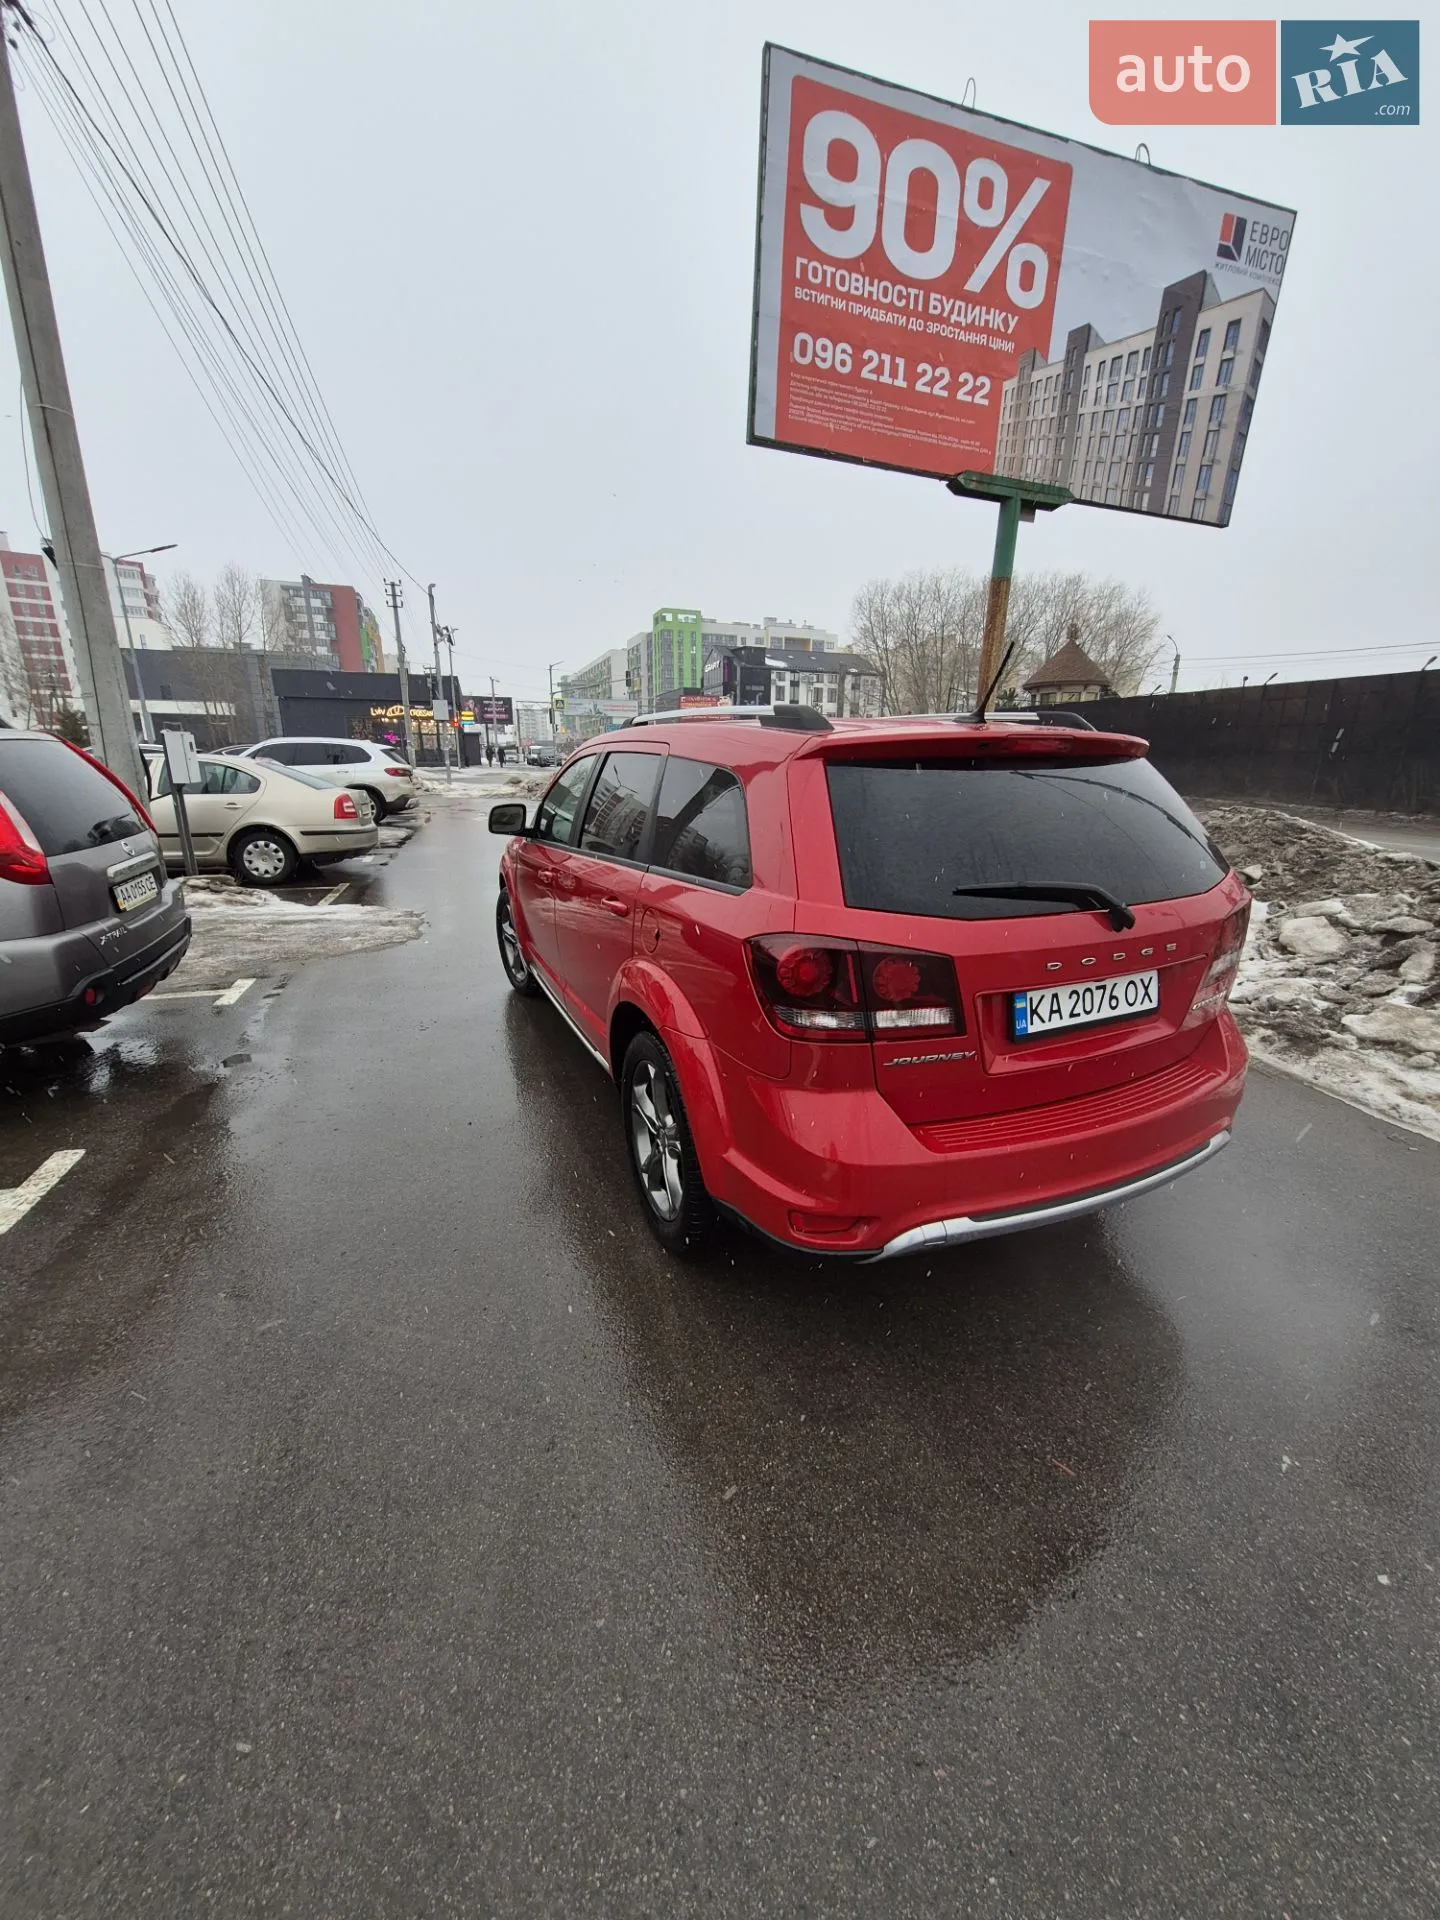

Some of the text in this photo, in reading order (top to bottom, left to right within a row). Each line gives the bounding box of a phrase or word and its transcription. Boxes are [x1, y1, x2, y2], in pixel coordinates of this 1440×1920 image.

[799, 109, 1052, 310] 90%
[1249, 220, 1290, 252] ЕВРО
[1244, 245, 1285, 275] МІСТО
[794, 256, 1020, 336] ГОТОВНОСТІ БУДИНКУ
[794, 286, 1015, 354] ВСТИГНИ ПРИДБАТИ ДО ЗРОСТАННЯ ЦІНИ!
[792, 331, 992, 406] 096 211 22 22
[99, 926, 127, 946] X-TRAIL
[1046, 942, 1178, 970] DODGE
[1028, 989, 1065, 1027] KA
[1068, 982, 1120, 1020] 2076
[1124, 975, 1154, 1005] OX
[1015, 1019, 1028, 1031] UA
[883, 1050, 976, 1067] JOURNEY
